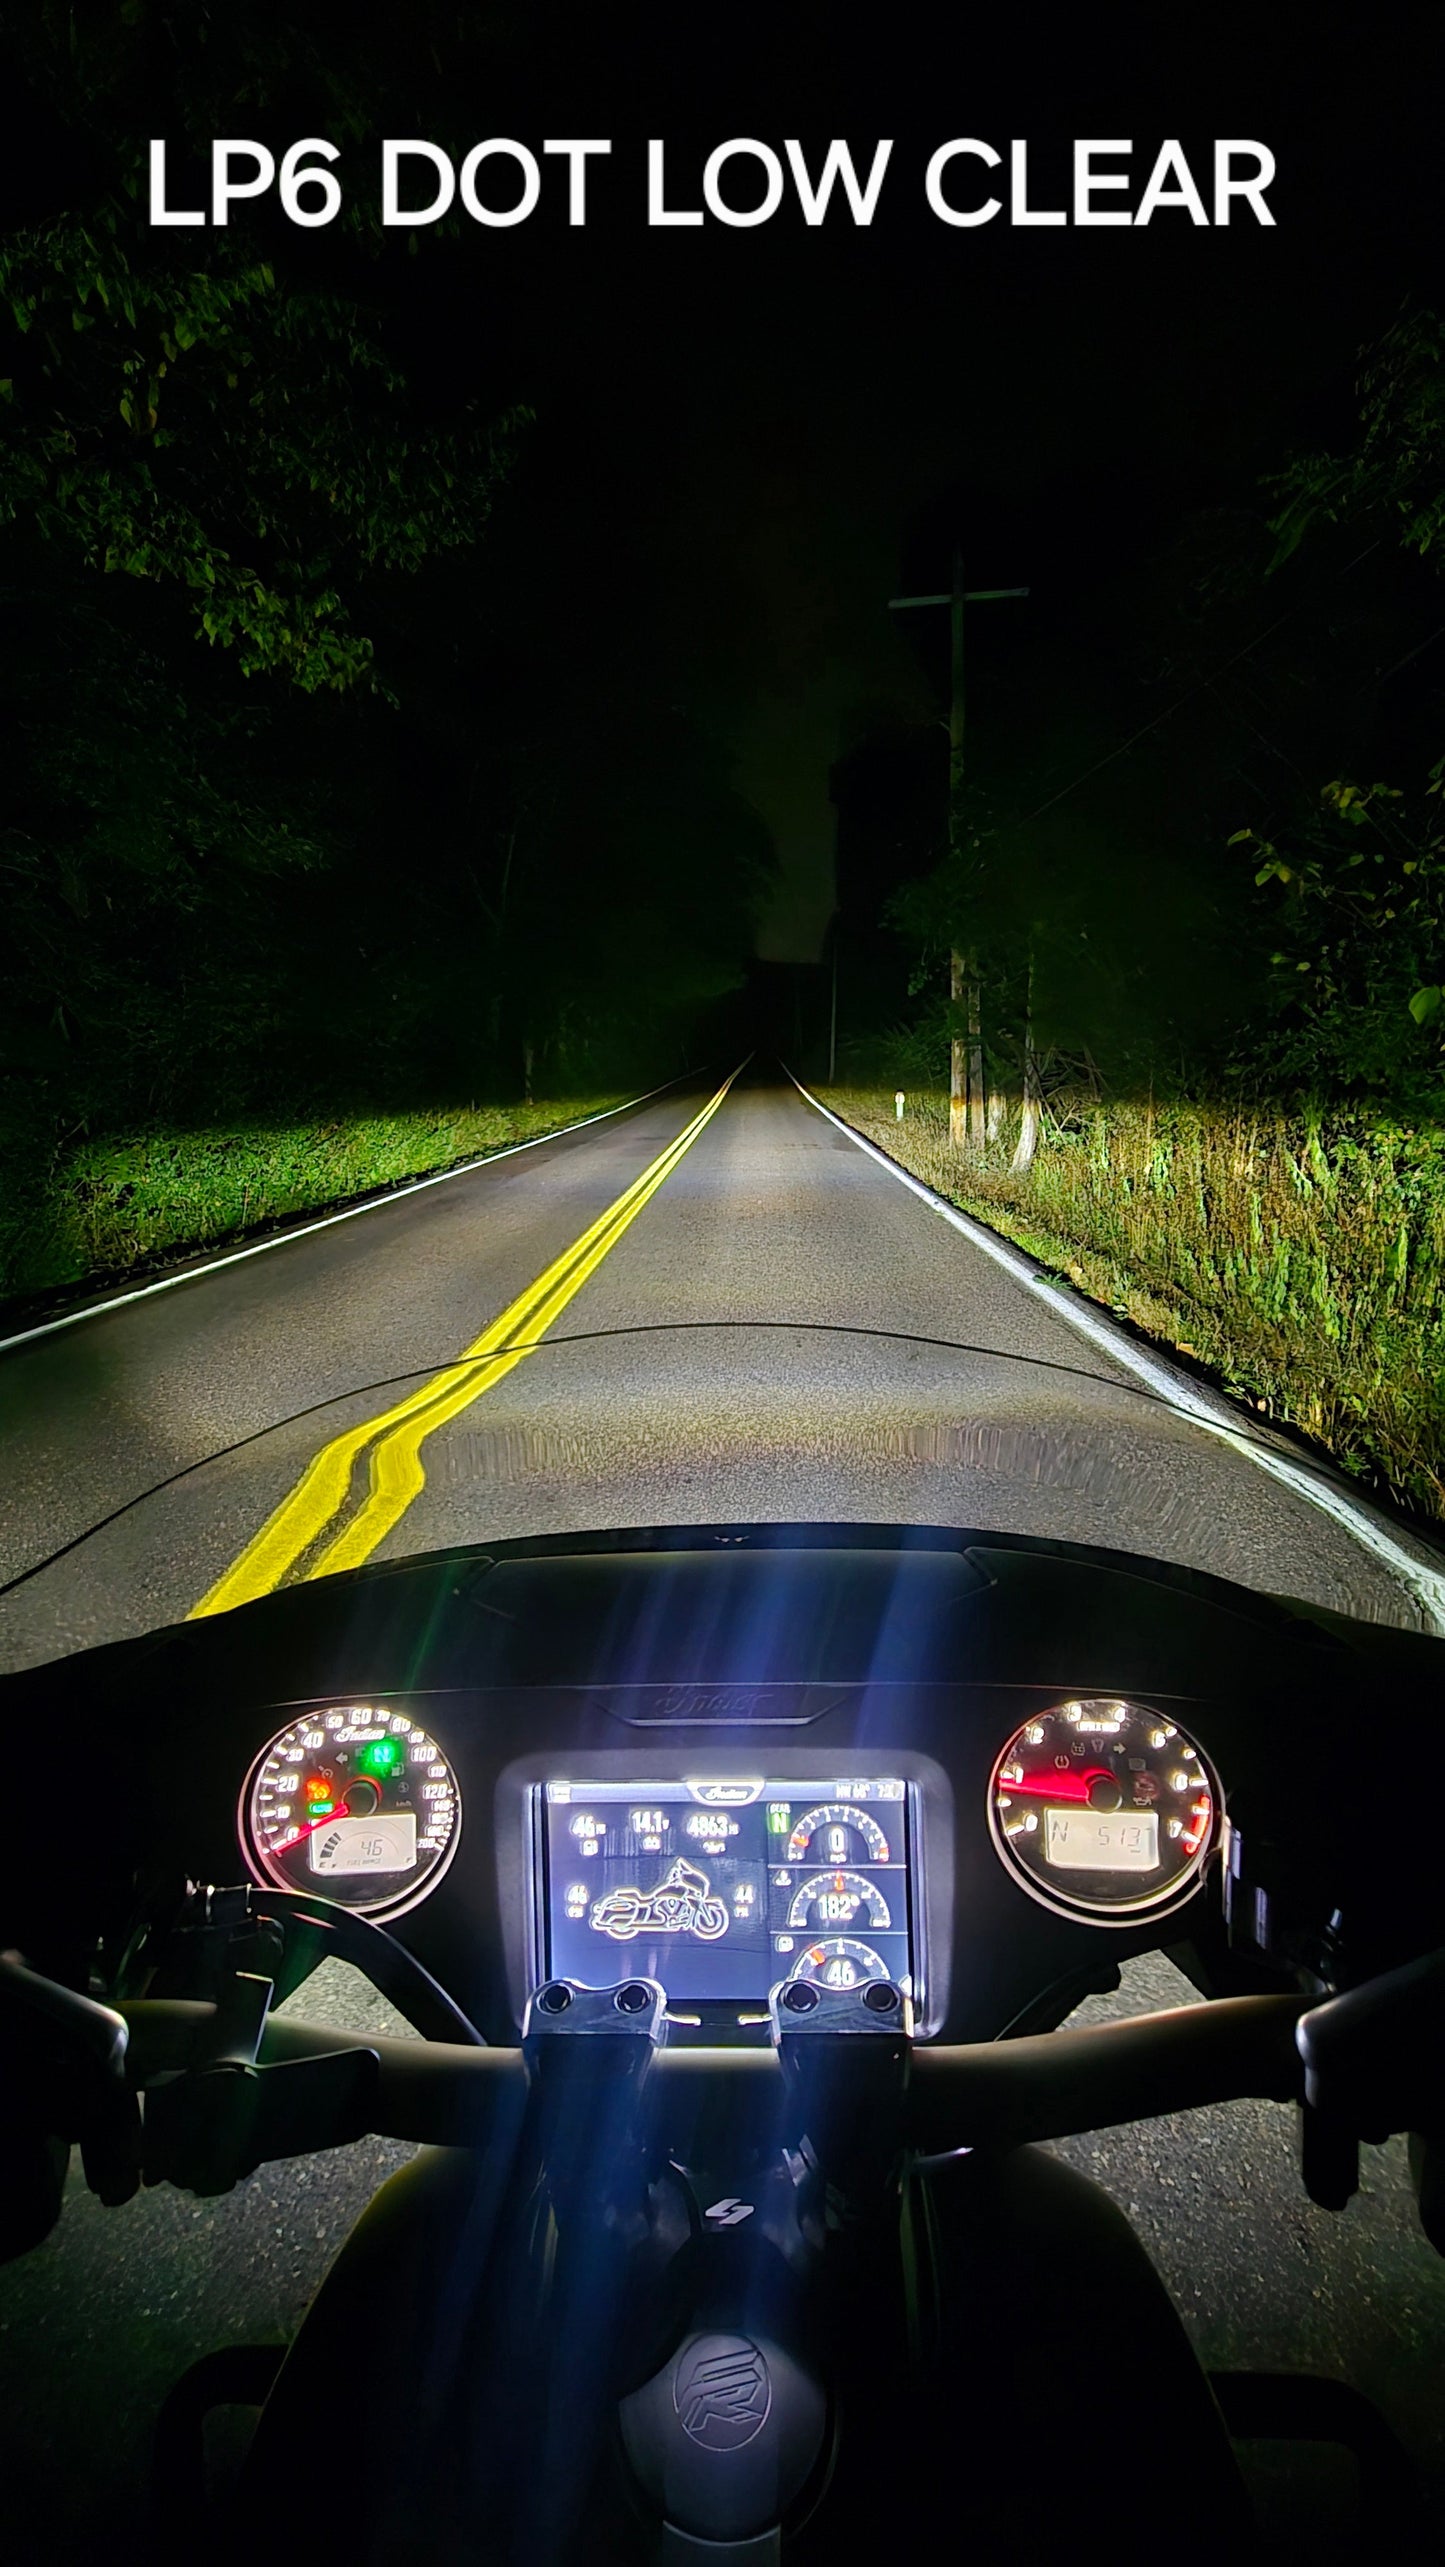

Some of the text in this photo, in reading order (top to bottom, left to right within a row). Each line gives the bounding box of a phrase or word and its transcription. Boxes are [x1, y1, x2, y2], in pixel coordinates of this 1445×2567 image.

[351, 1708, 371, 1725] 60
[1068, 1704, 1082, 1721] 3
[327, 1716, 343, 1729] 50
[391, 1717, 411, 1732] 80
[302, 1732, 324, 1749] 40
[1030, 1728, 1045, 1744] 2
[286, 1749, 304, 1761] 30
[373, 1748, 392, 1763] N
[412, 1747, 437, 1762] 100
[277, 1776, 298, 1792] 20
[1015, 1767, 1024, 1784] 1
[423, 1784, 447, 1799] 120
[572, 1815, 595, 1838] 46
[687, 1815, 728, 1838] 4863
[773, 1814, 789, 1833] N
[1024, 1814, 1038, 1832] 0
[1051, 1820, 1069, 1843] N
[1168, 1822, 1183, 1839] 7
[360, 1839, 383, 1856] 46
[831, 1828, 844, 1853] 0
[827, 1961, 855, 1987] 46
